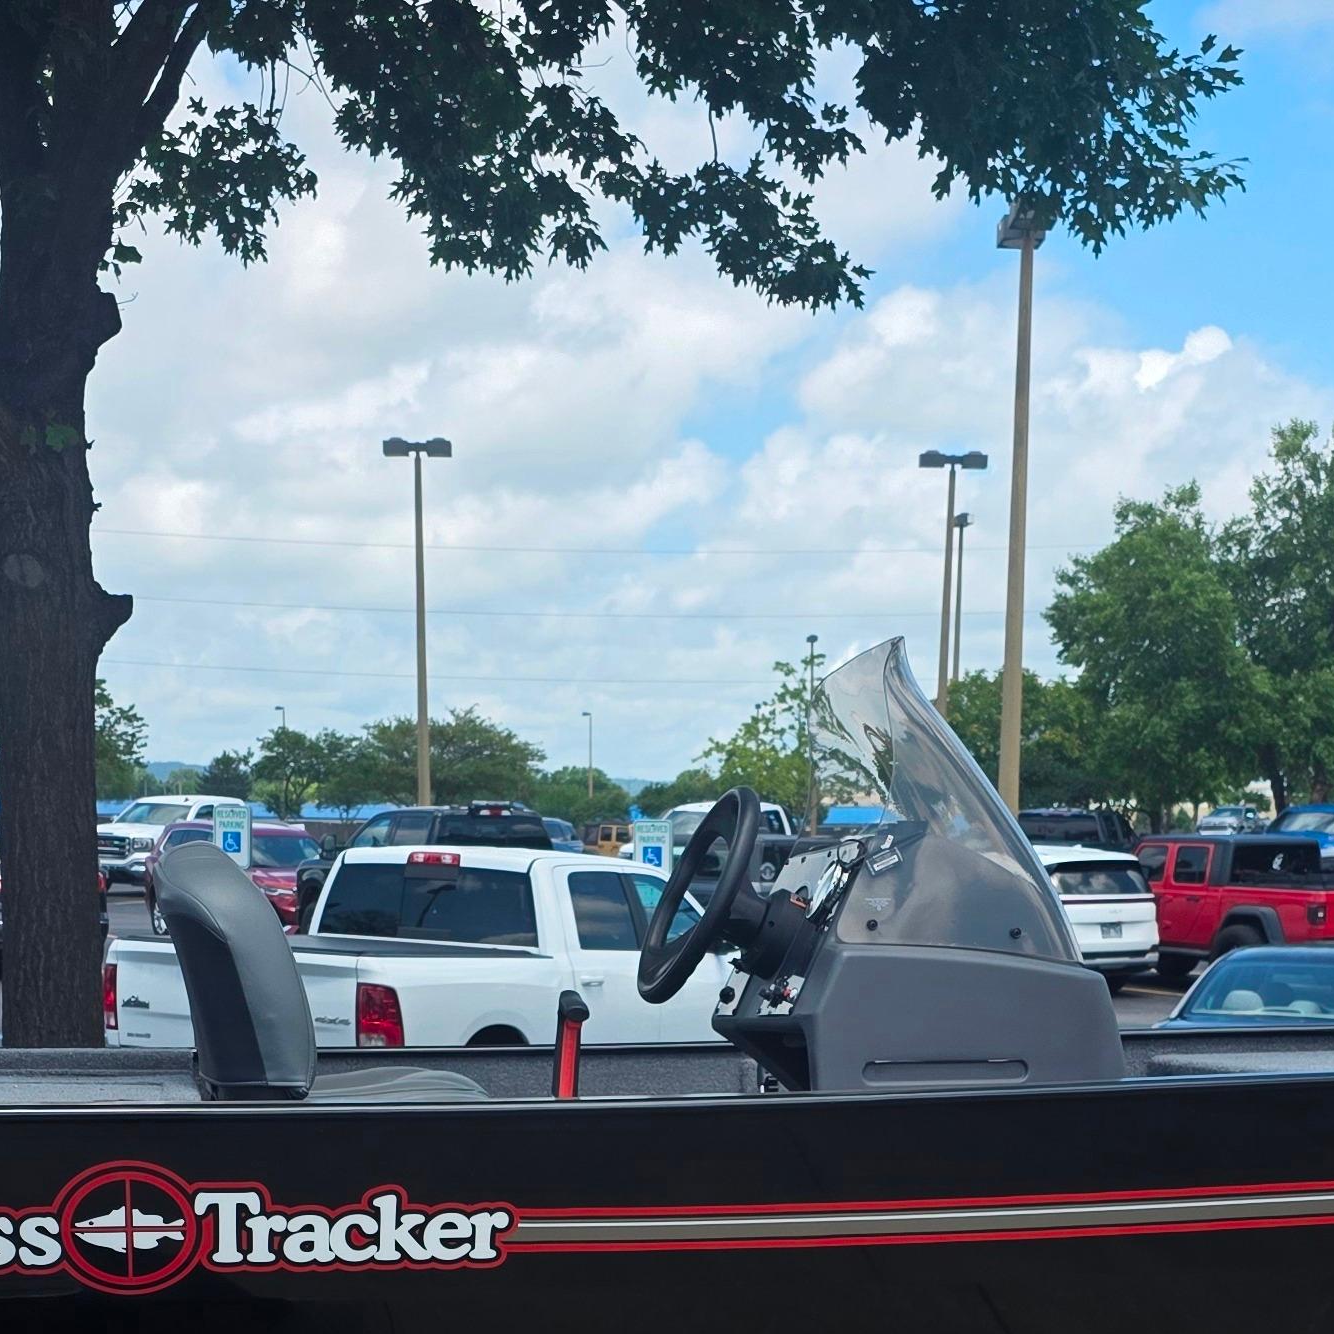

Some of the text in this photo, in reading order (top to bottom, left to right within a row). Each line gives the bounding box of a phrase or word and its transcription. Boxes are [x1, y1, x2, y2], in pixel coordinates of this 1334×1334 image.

[216, 809, 247, 819] RESERVED
[218, 820, 245, 829] PARKING
[194, 1191, 509, 1264] Tracker
